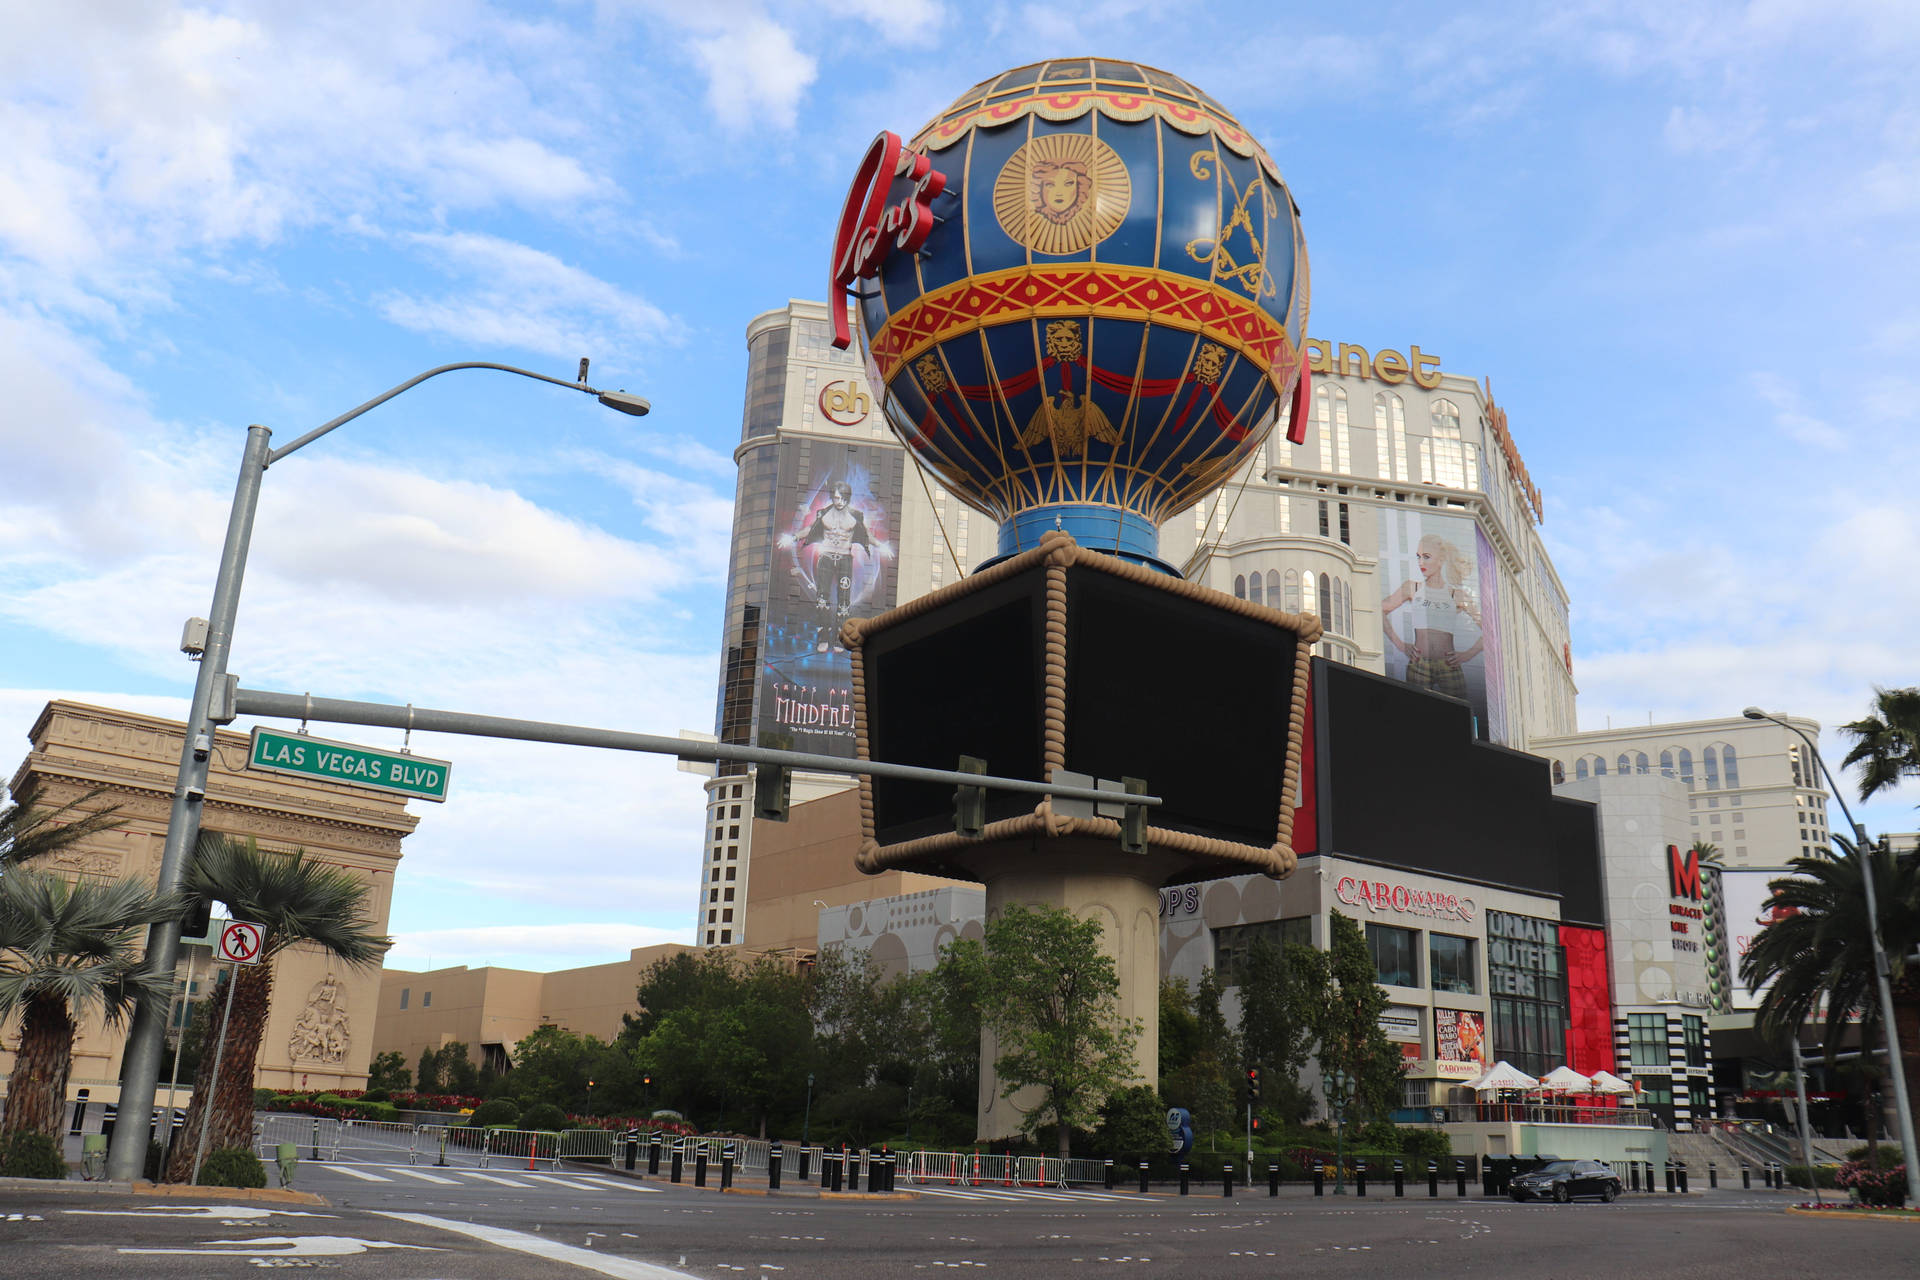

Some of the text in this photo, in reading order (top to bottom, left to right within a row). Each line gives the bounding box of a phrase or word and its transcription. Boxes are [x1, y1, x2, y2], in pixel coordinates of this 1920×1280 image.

[824, 381, 870, 416] ph
[773, 682, 817, 693] CRISS
[262, 741, 439, 788] LAS VEGAS BLVD
[1667, 844, 1703, 902] M
[1335, 876, 1411, 913] CABO
[1488, 911, 1548, 941] URBAN
[1670, 920, 1689, 934] MILE
